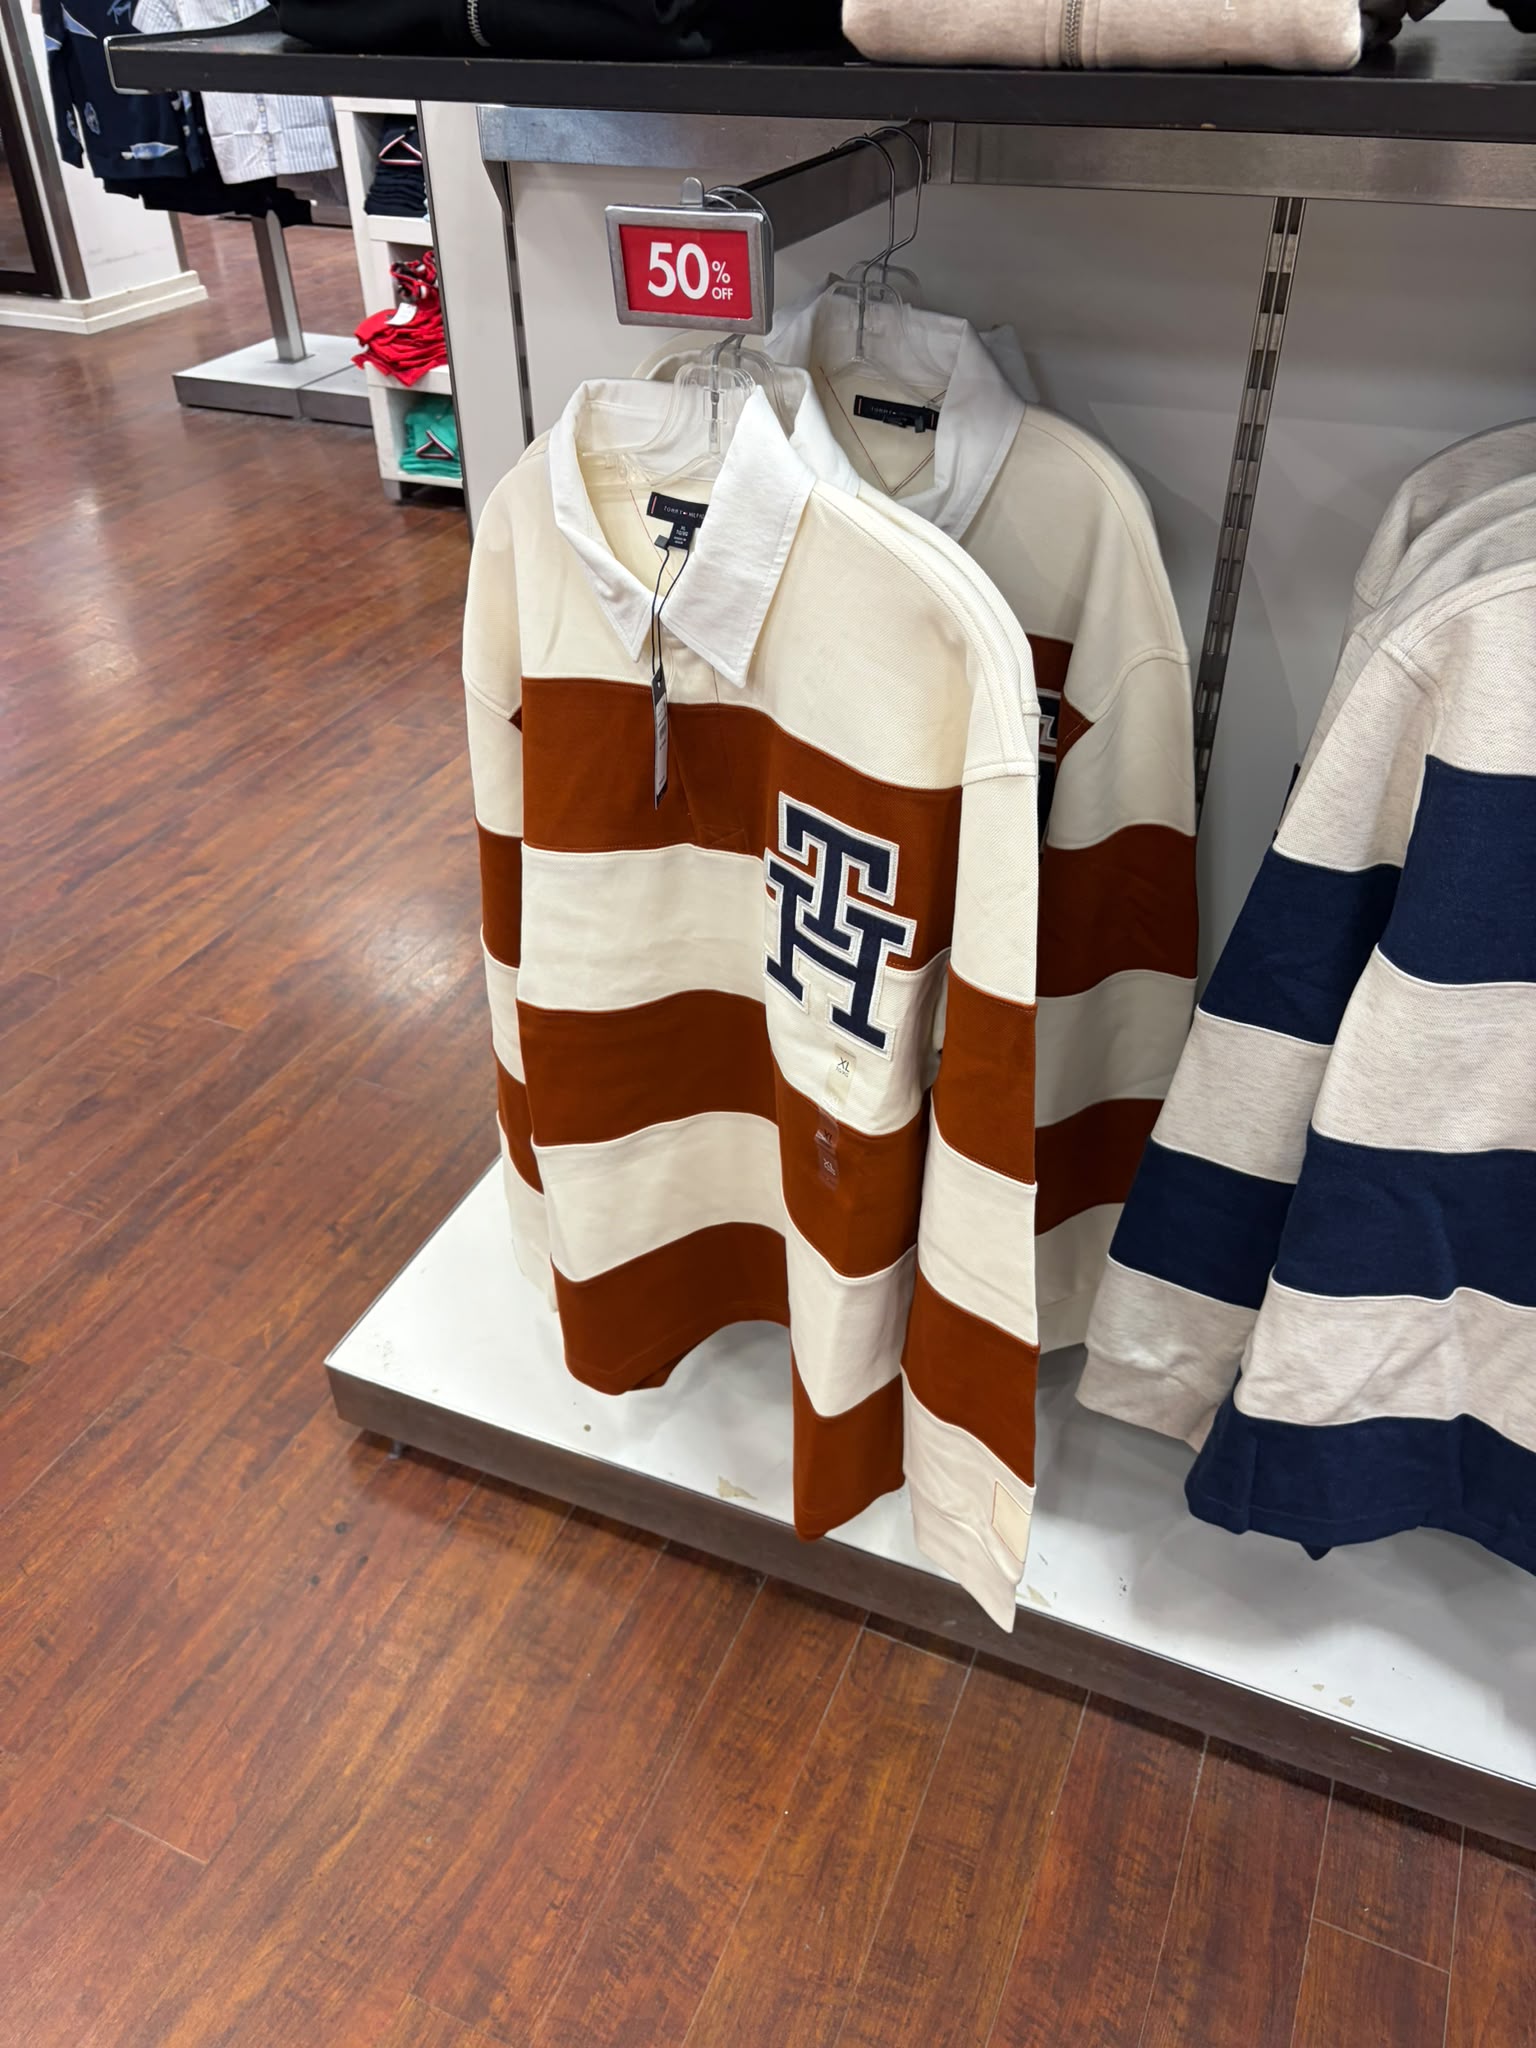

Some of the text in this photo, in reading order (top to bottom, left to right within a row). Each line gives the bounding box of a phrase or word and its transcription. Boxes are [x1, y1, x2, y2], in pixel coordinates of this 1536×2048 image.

[711, 287, 734, 301] OFF
[663, 505, 705, 520] TOMMY HILFIG
[837, 1056, 850, 1073] XL
